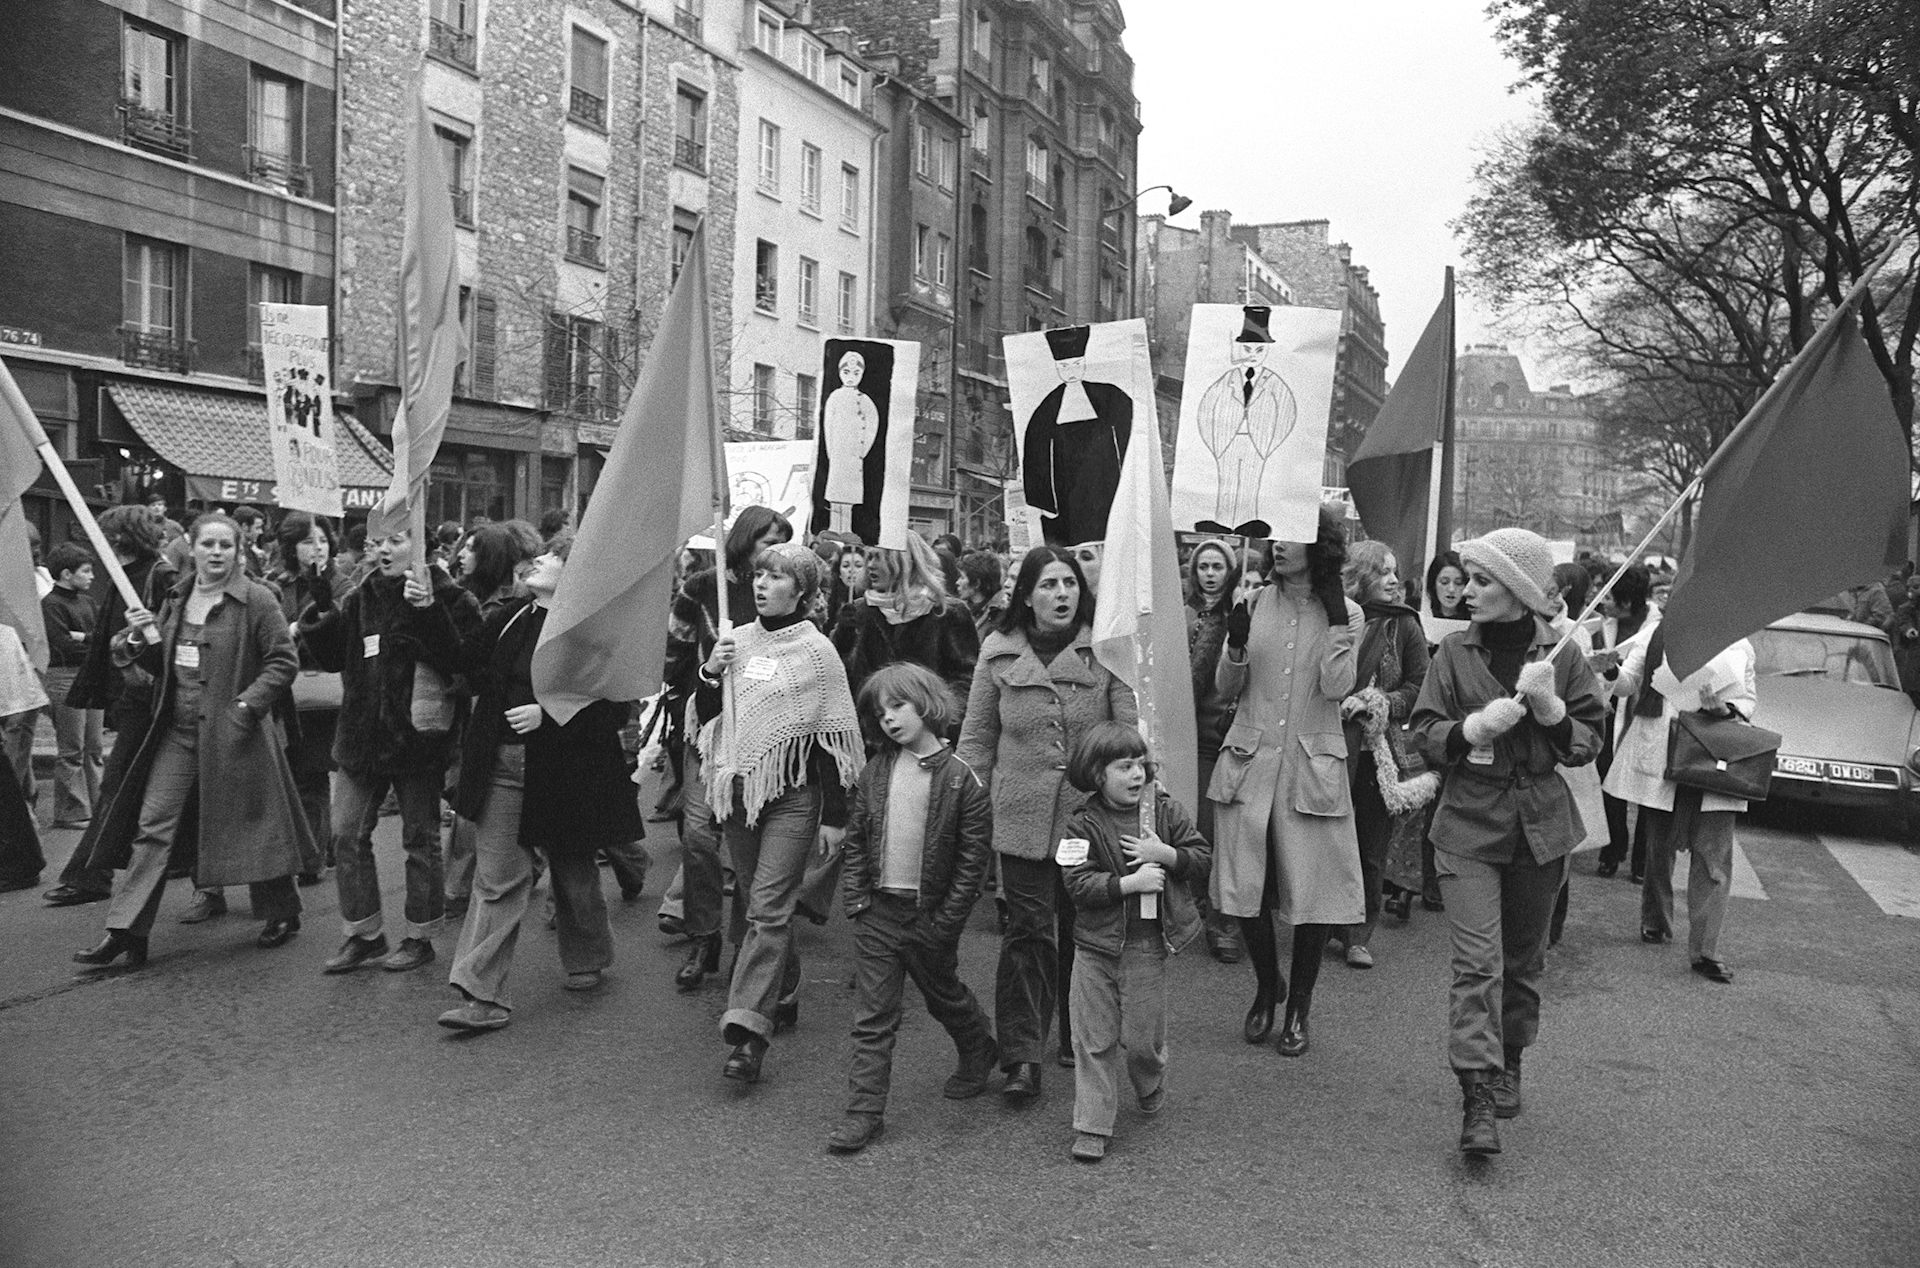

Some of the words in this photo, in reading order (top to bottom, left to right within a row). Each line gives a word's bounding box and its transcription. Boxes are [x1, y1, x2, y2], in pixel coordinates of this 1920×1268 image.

[3, 329, 19, 342] 76
[22, 331, 38, 345] 74
[289, 349, 317, 368] PLUS
